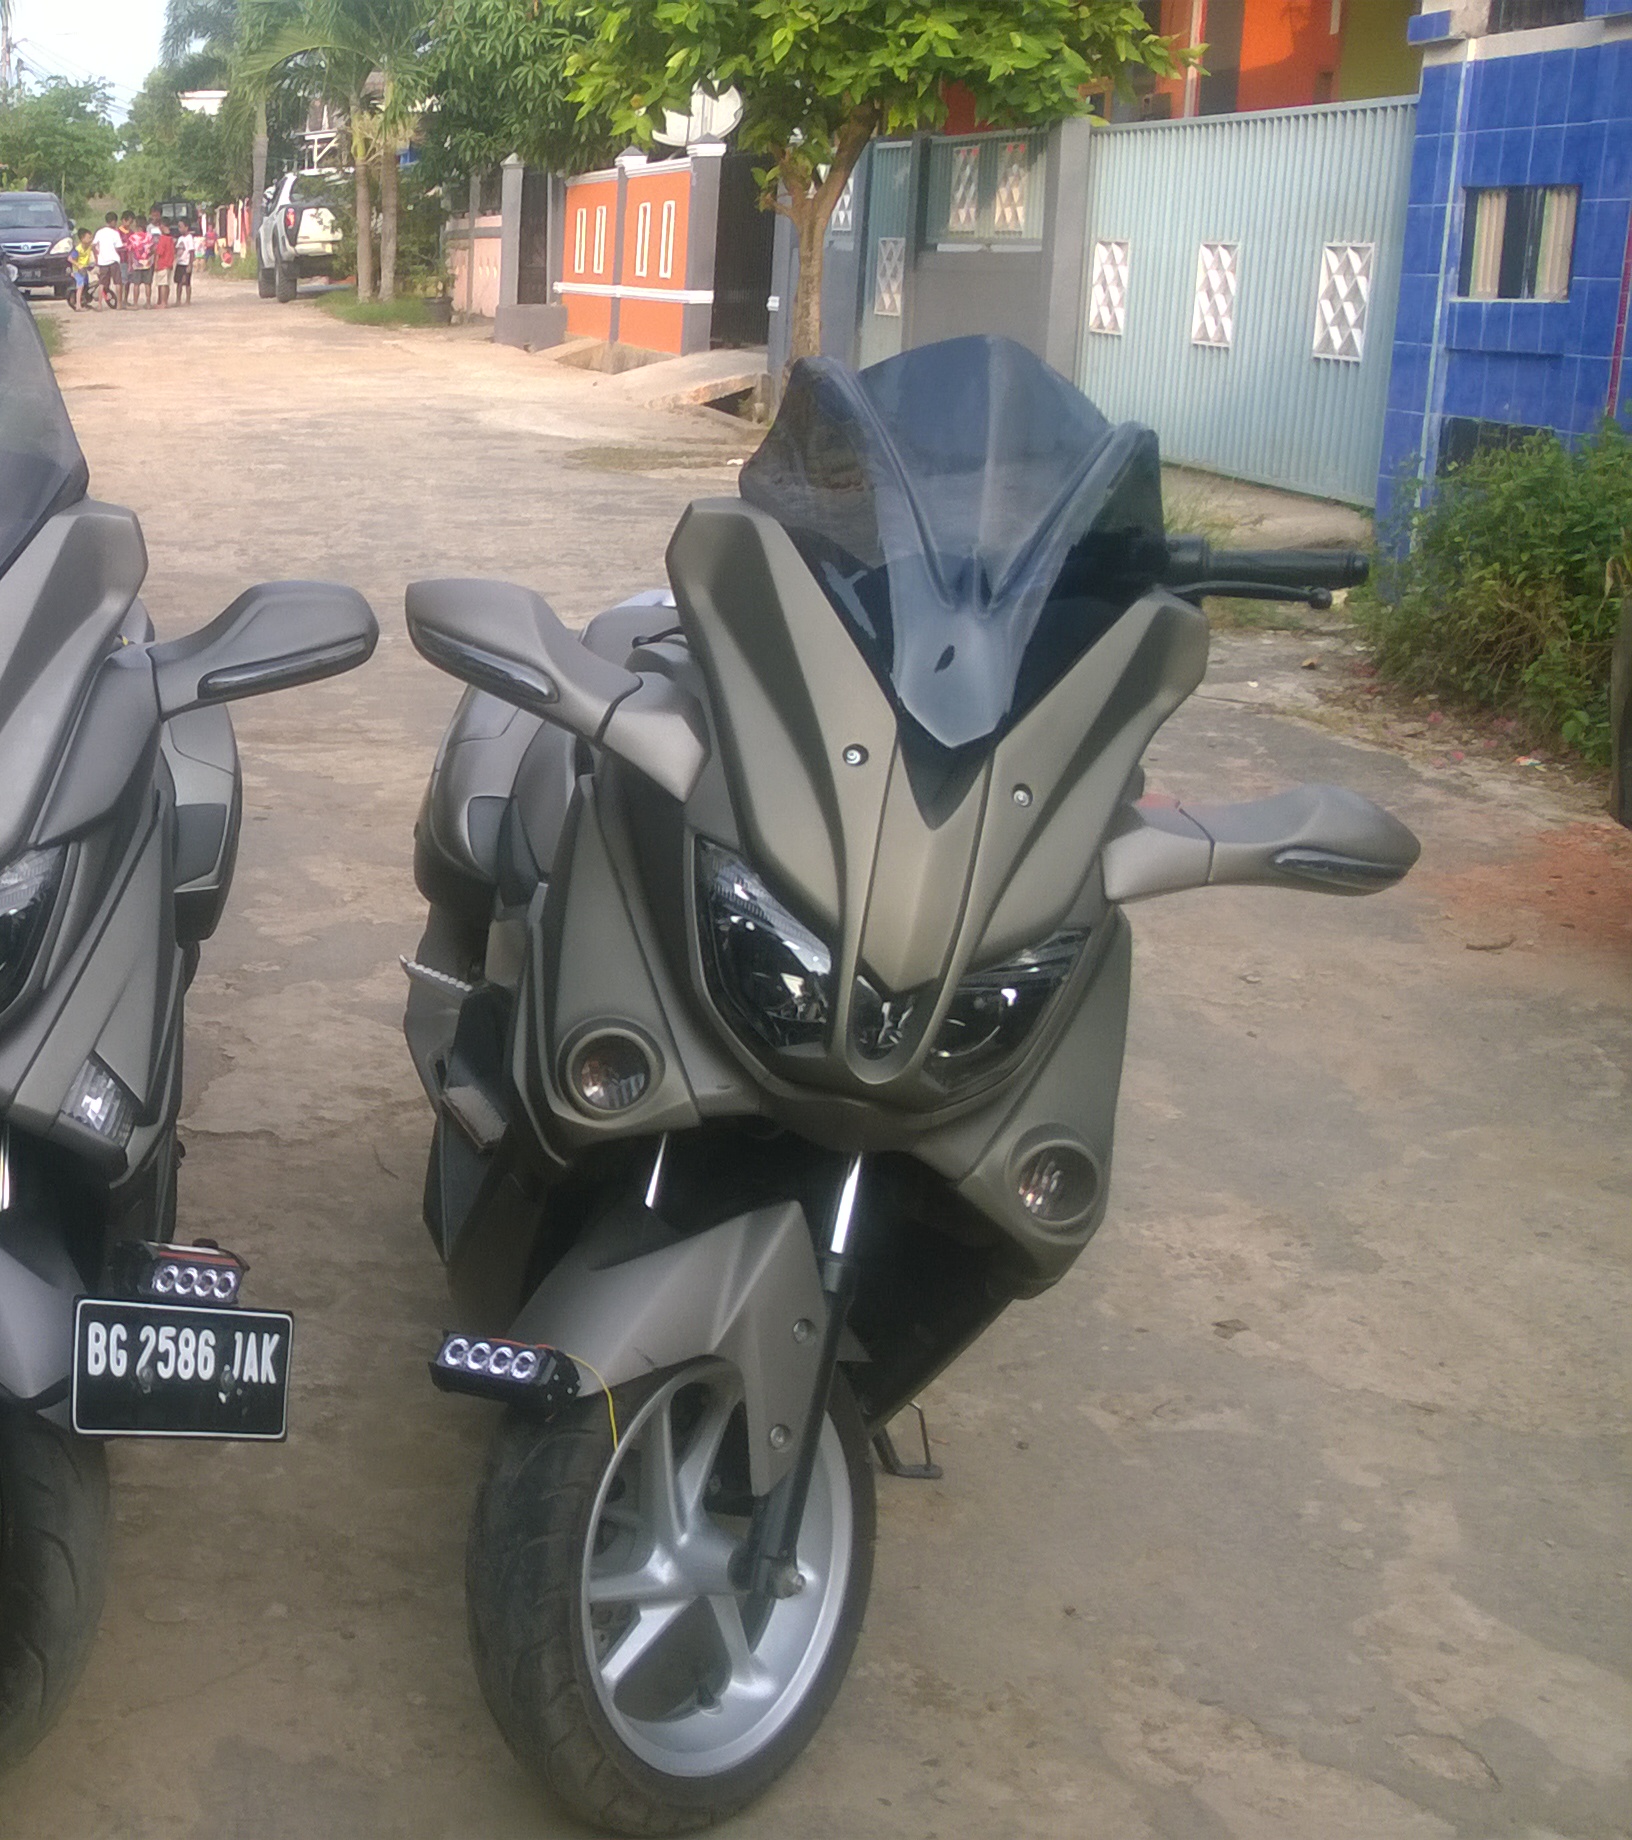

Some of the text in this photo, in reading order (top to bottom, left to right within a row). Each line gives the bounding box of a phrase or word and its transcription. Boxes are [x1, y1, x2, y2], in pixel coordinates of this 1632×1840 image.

[87, 1321, 280, 1385] BG 2586 JAK
